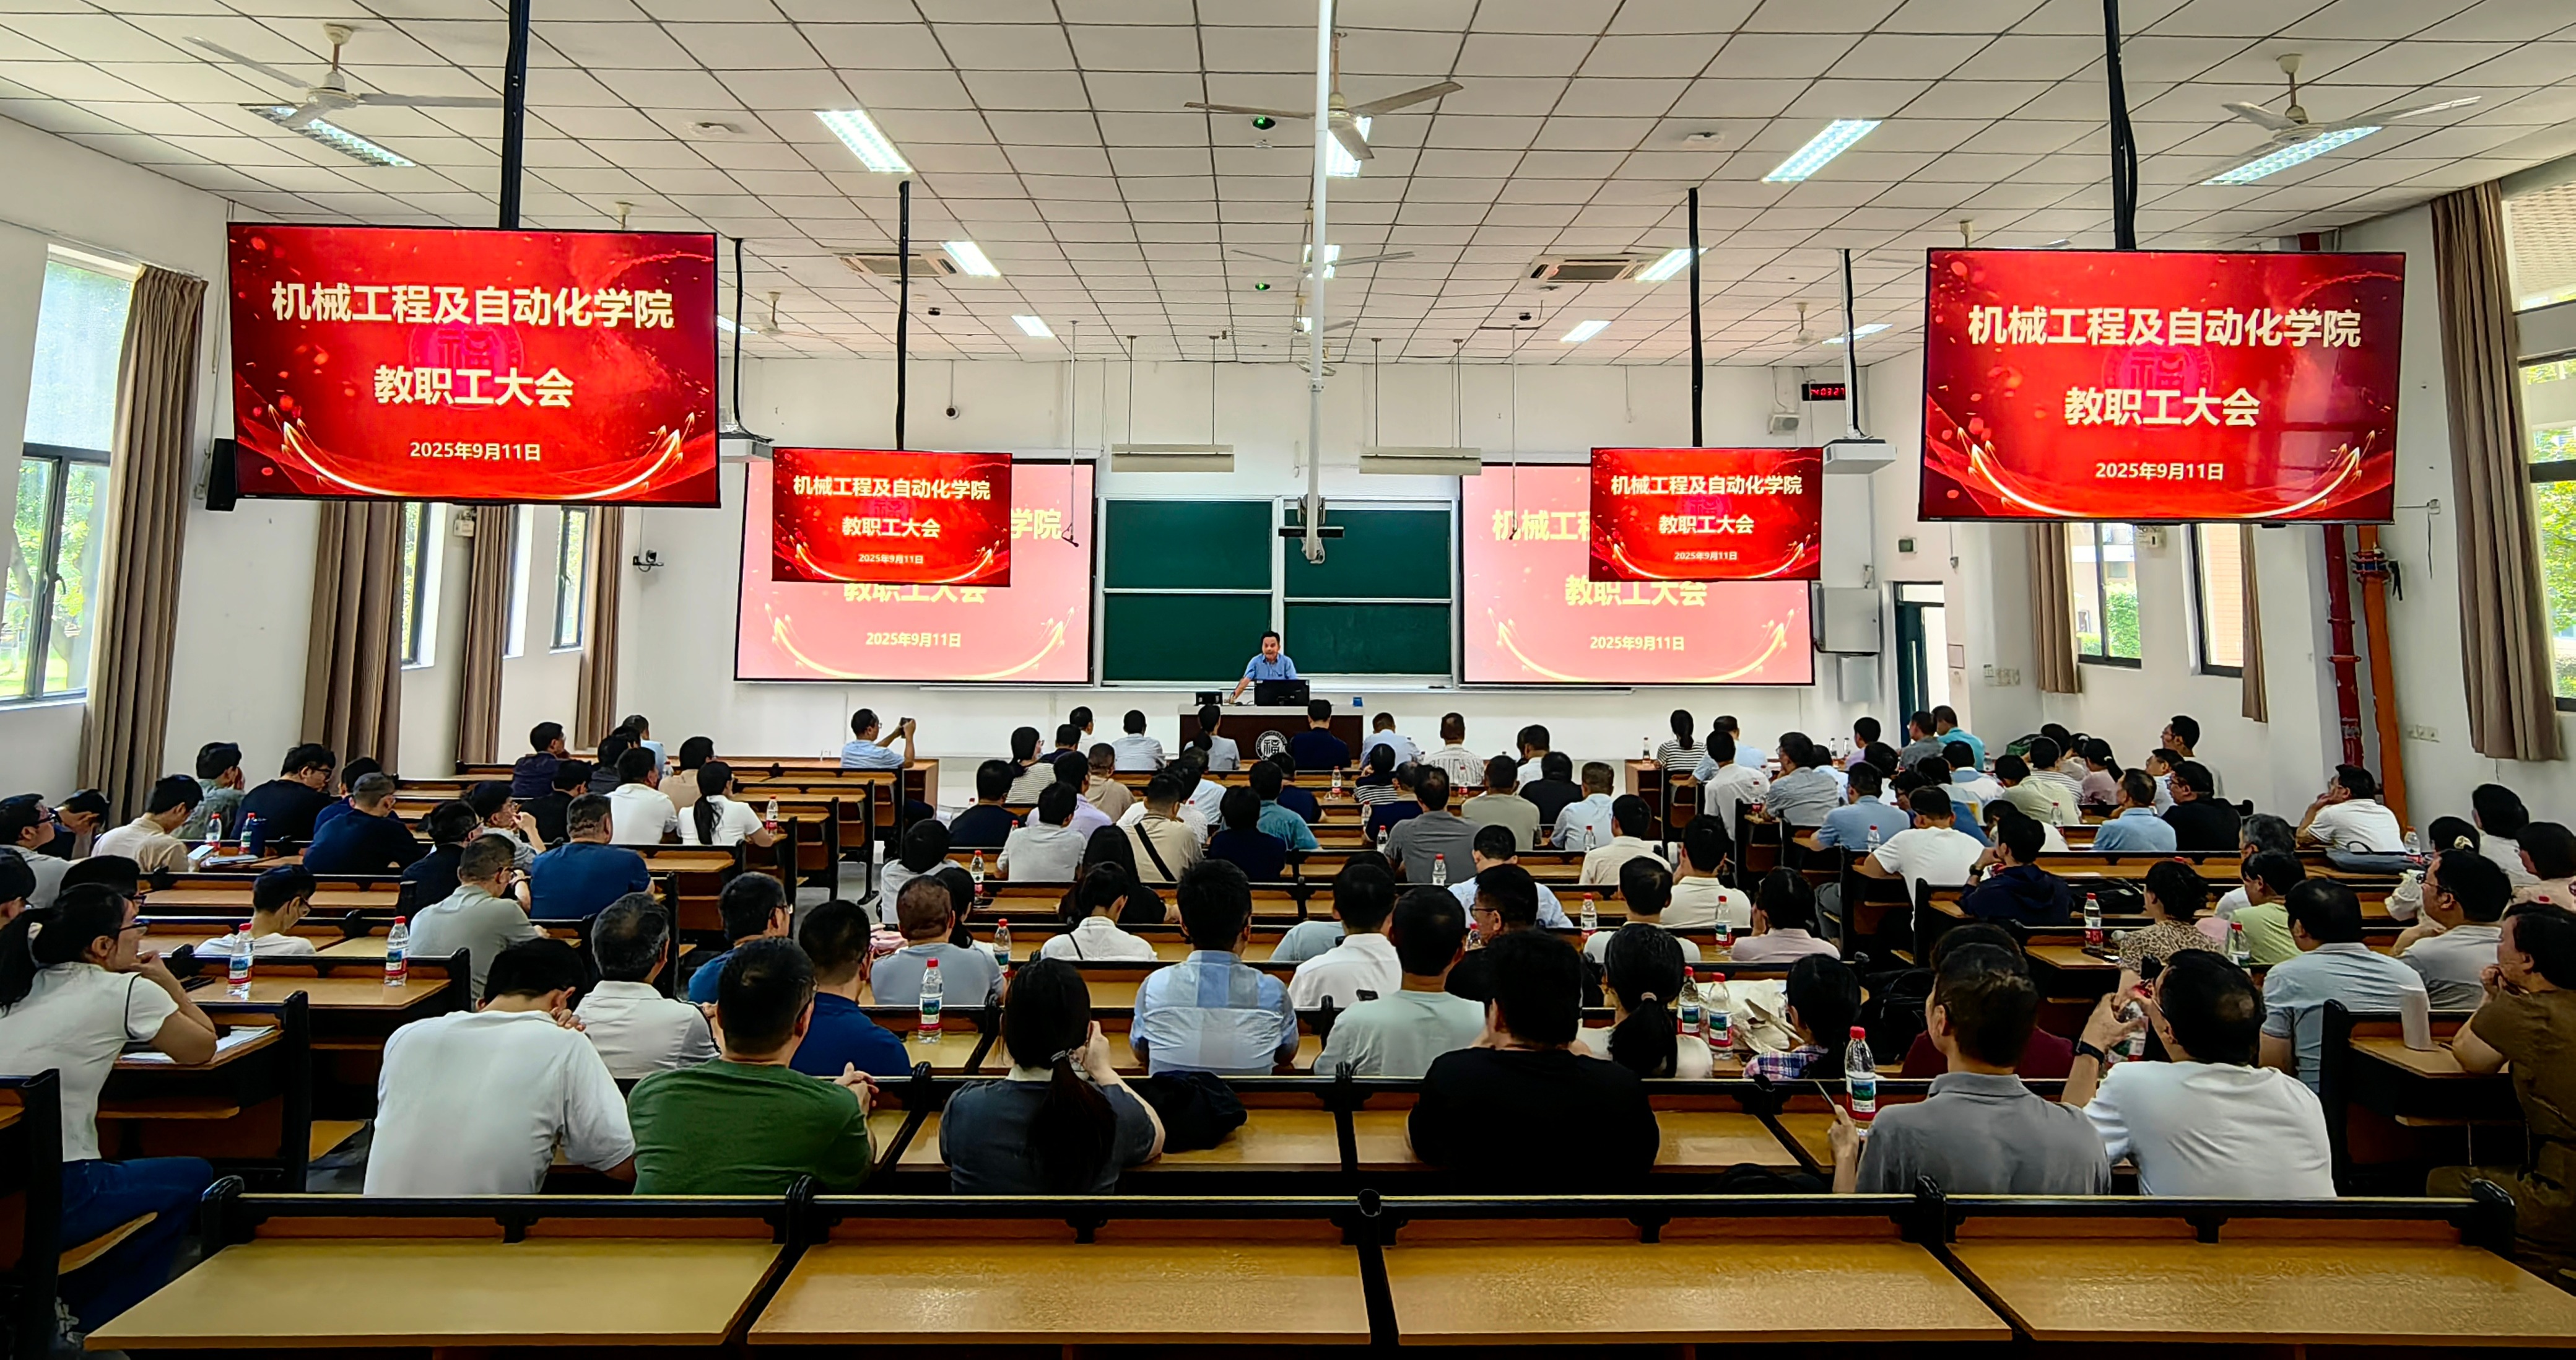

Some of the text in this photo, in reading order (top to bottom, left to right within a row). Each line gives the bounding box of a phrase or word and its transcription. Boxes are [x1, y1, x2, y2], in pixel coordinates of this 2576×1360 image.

[271, 281, 674, 328] 机械工程及自动化学院
[1968, 305, 2362, 348] 机械工程及自动化学院
[374, 365, 574, 407] 教职工大会
[2065, 388, 2261, 427] 教职工大会
[409, 440, 542, 462] 2025年9月11日
[2095, 461, 2224, 481] 2025年9月11日
[793, 475, 991, 500] 机械工程及自动化学院
[1611, 474, 1803, 495] 机械工程及自动化学院
[842, 517, 941, 538] 教职工大会
[1659, 514, 1755, 534] 教职工大会
[858, 553, 924, 564] 2025年9月11日
[1674, 551, 1738, 561] 2025年9月11日
[865, 632, 961, 647] 2025年9月11日
[1590, 635, 1684, 651] 2025年9月11日
